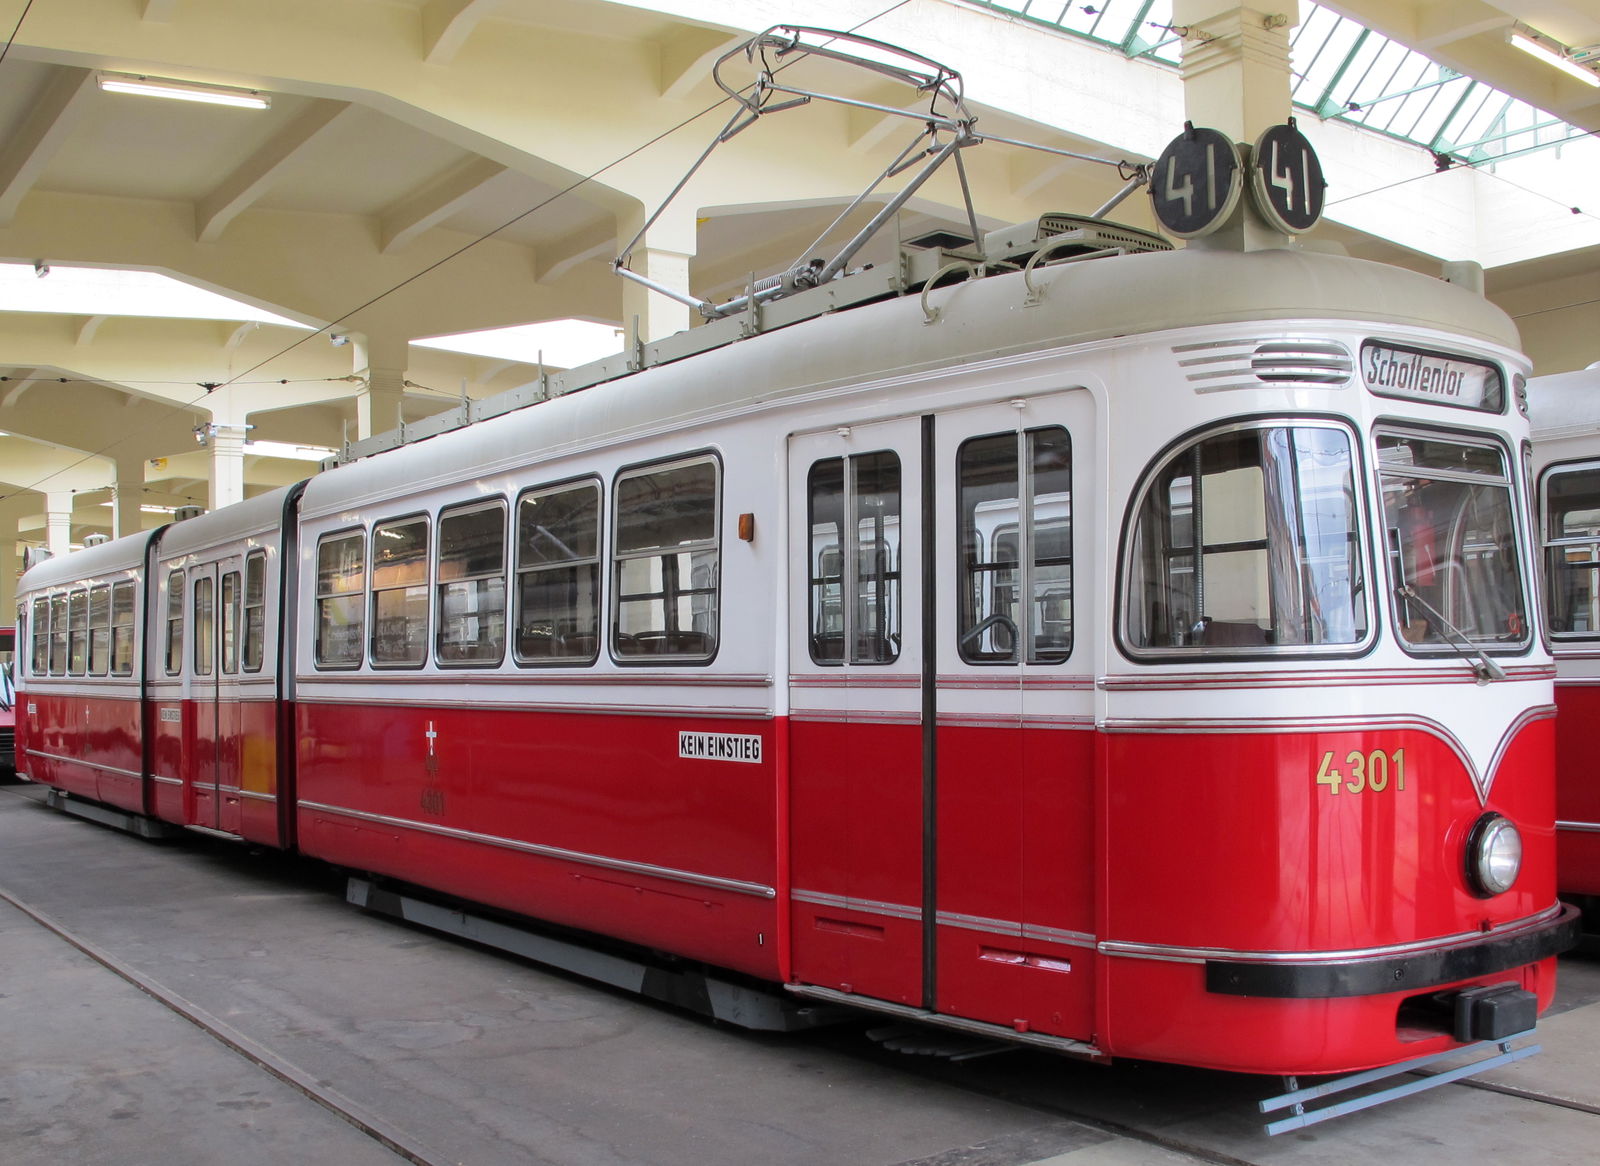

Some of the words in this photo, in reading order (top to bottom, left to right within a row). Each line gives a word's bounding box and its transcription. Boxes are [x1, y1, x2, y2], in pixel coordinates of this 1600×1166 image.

[1165, 143, 1216, 217] 41
[1271, 139, 1311, 215] 41
[1367, 346, 1466, 397] Schottentor
[681, 734, 705, 756] KEIN
[708, 736, 760, 760] EINSTIEG
[1316, 748, 1405, 796] 4301
